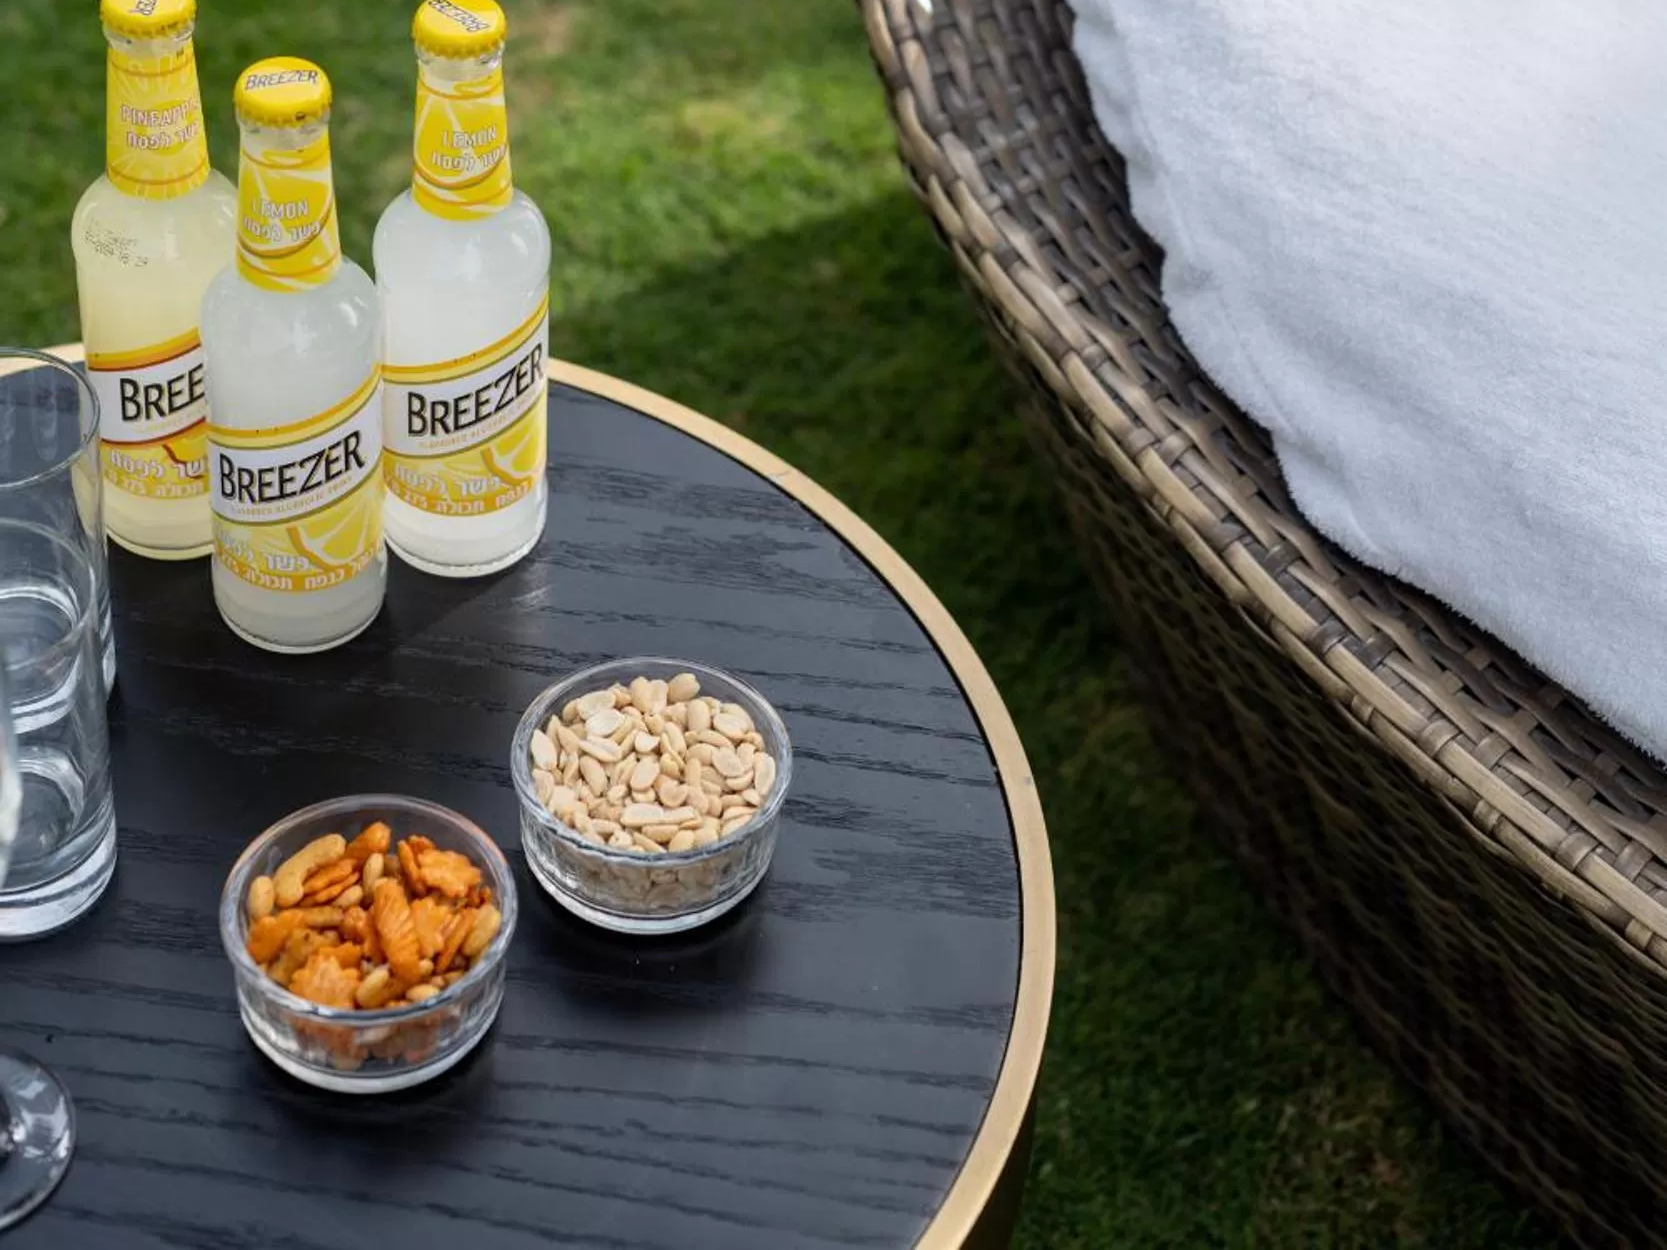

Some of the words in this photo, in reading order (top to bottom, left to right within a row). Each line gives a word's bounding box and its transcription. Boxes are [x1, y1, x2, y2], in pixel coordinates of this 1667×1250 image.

[244, 69, 318, 91] BREEZER
[441, 125, 497, 149] LEMON
[251, 196, 310, 220] LEMON
[118, 362, 206, 422] BREE
[406, 342, 545, 437] BREEZER
[176, 457, 206, 479] שר
[219, 429, 366, 503] BREEZER
